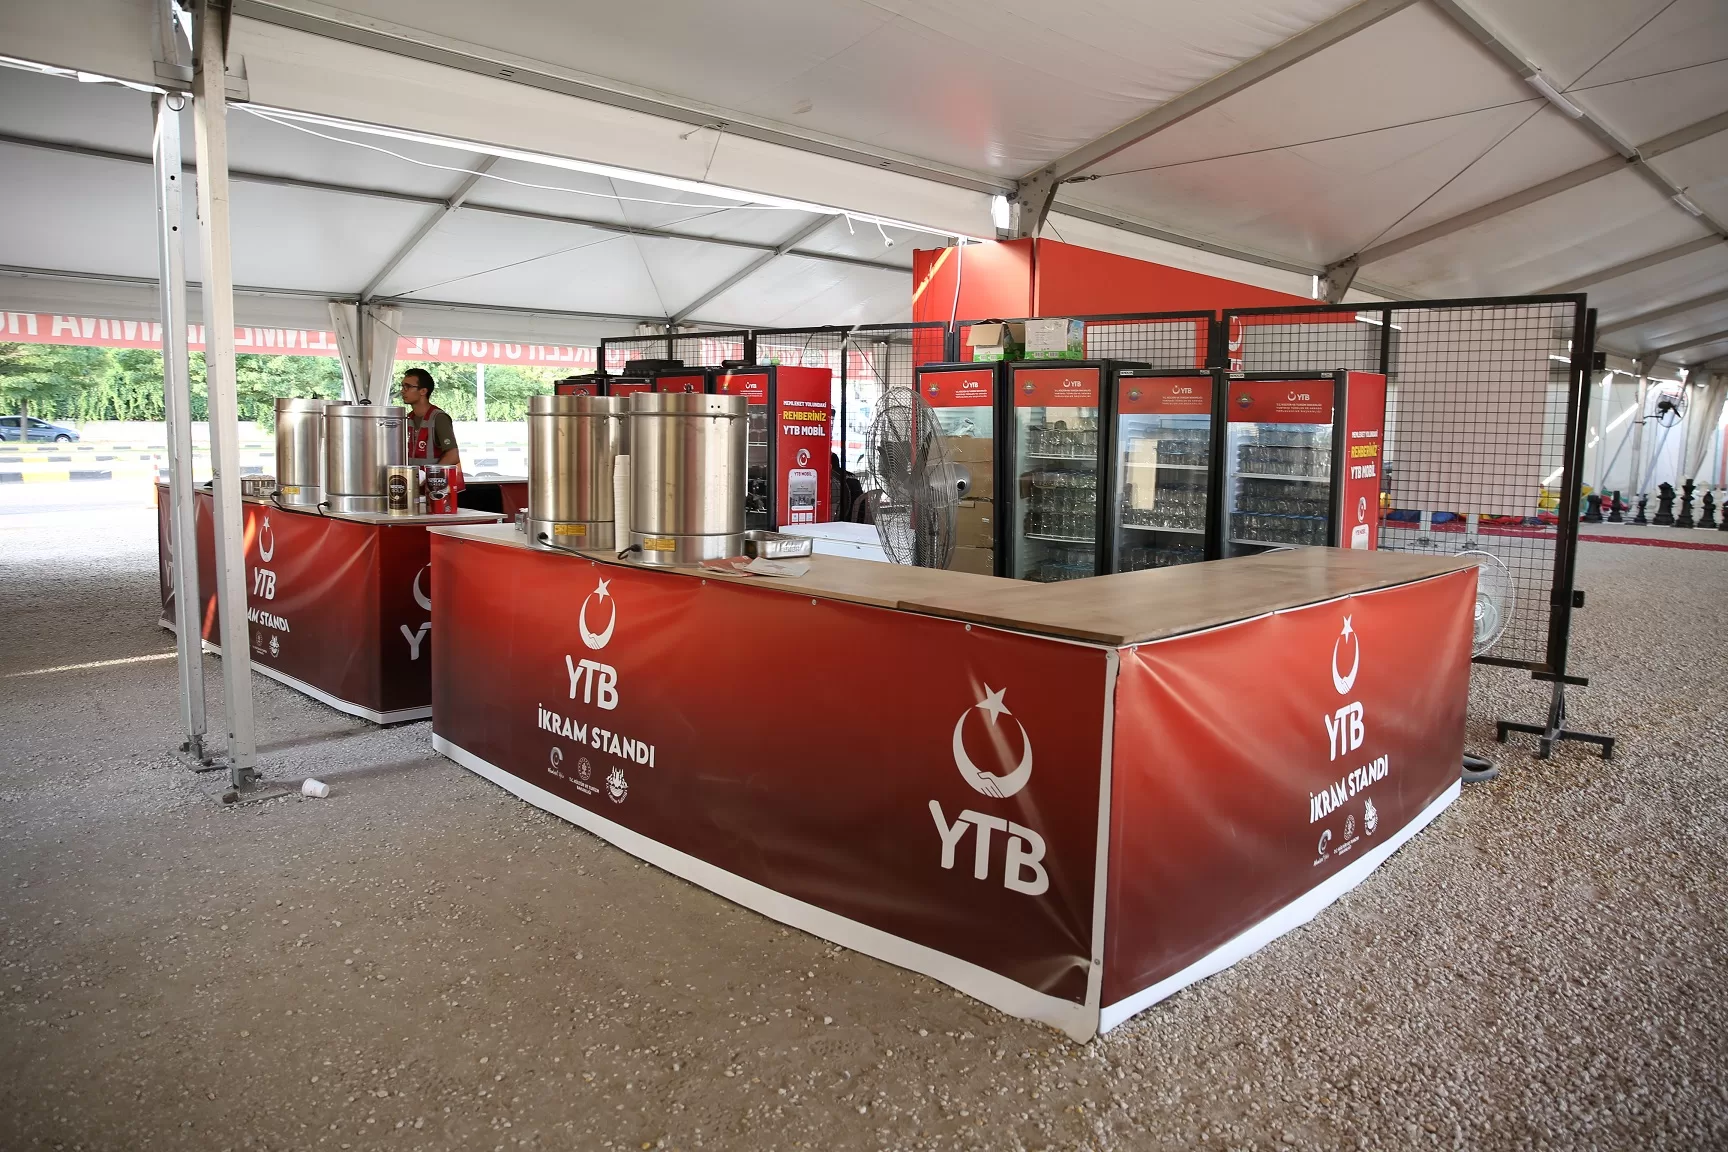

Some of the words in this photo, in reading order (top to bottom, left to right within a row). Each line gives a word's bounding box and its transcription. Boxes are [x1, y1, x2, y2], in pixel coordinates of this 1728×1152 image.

[1296, 393, 1310, 401] YTB
[783, 410, 827, 421] REHBERİNİZ
[783, 425, 800, 436] YTB
[801, 424, 826, 436] MOBİL
[1350, 465, 1361, 480] YTB
[253, 566, 276, 600] YTB
[260, 611, 290, 633] STANDI
[565, 654, 619, 711] YTB
[538, 703, 587, 745] İKRAM
[591, 727, 656, 768] STANDI
[1324, 700, 1365, 762] YTB
[1309, 777, 1348, 824] İKRAM
[1347, 754, 1389, 797] STANDI
[928, 799, 1050, 896] YTB
